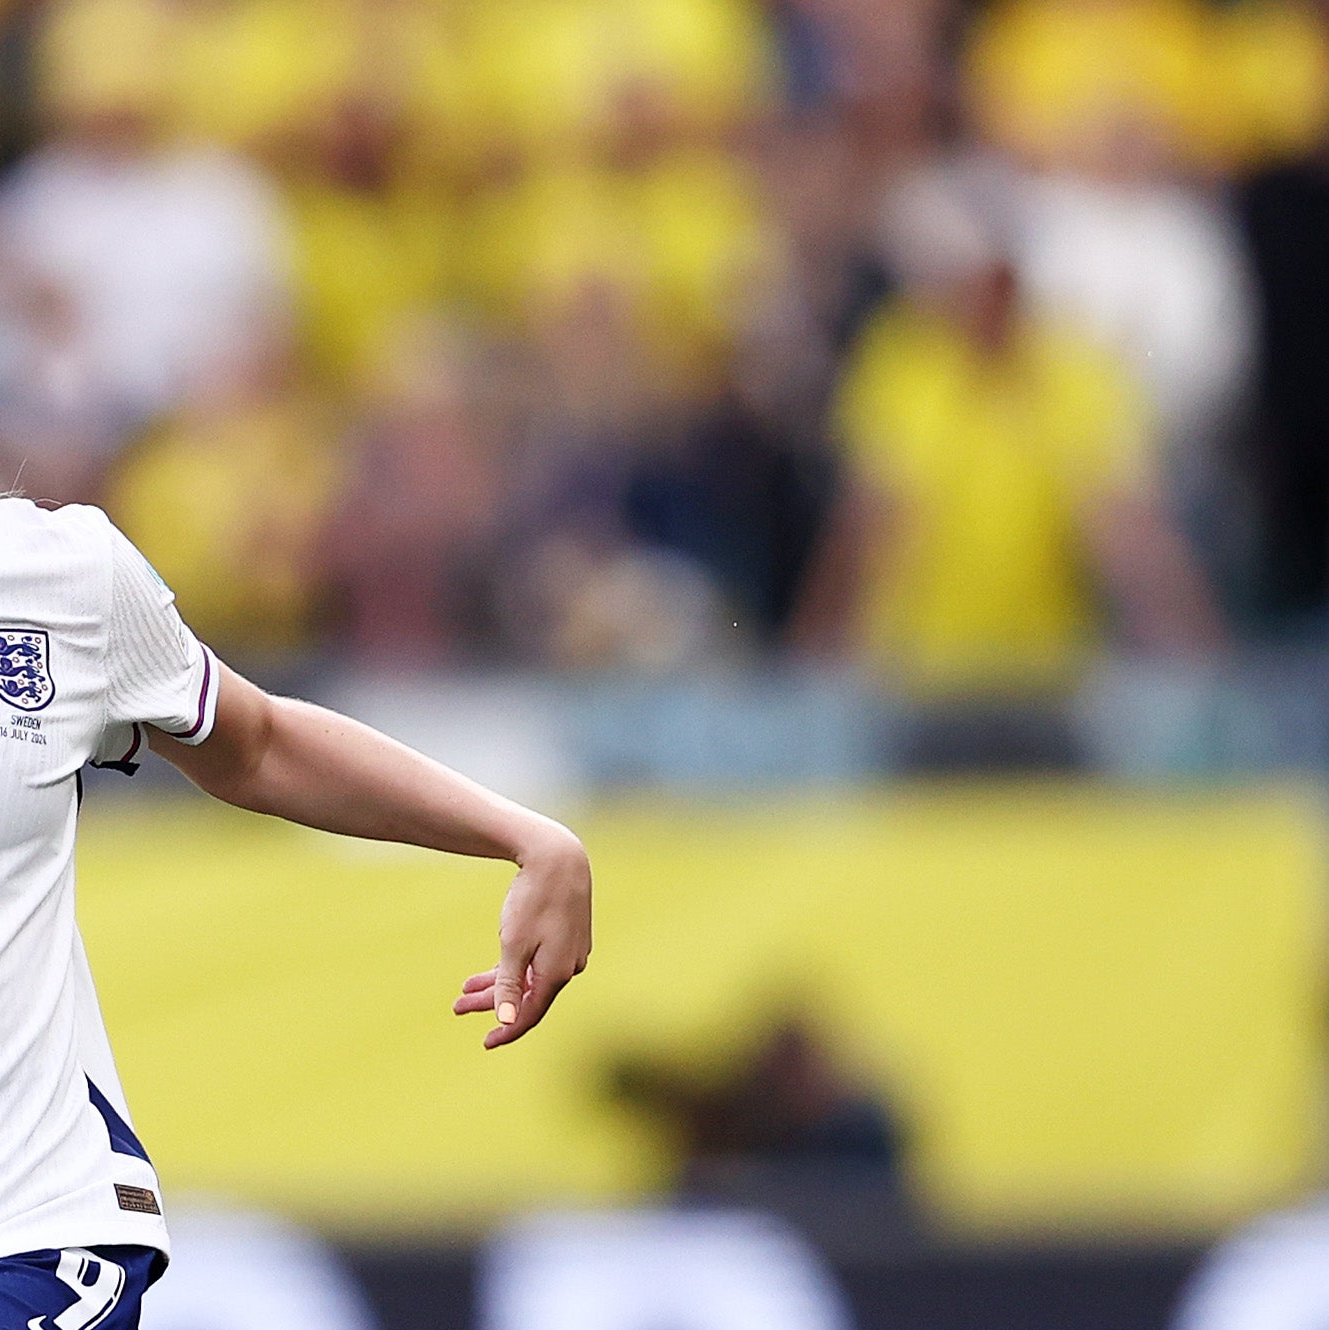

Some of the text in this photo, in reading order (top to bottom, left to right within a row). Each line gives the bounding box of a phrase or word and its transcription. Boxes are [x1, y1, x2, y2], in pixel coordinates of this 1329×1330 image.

[10, 715, 41, 729] SWEDEN
[0, 726, 46, 745] 16 JULY 2024
